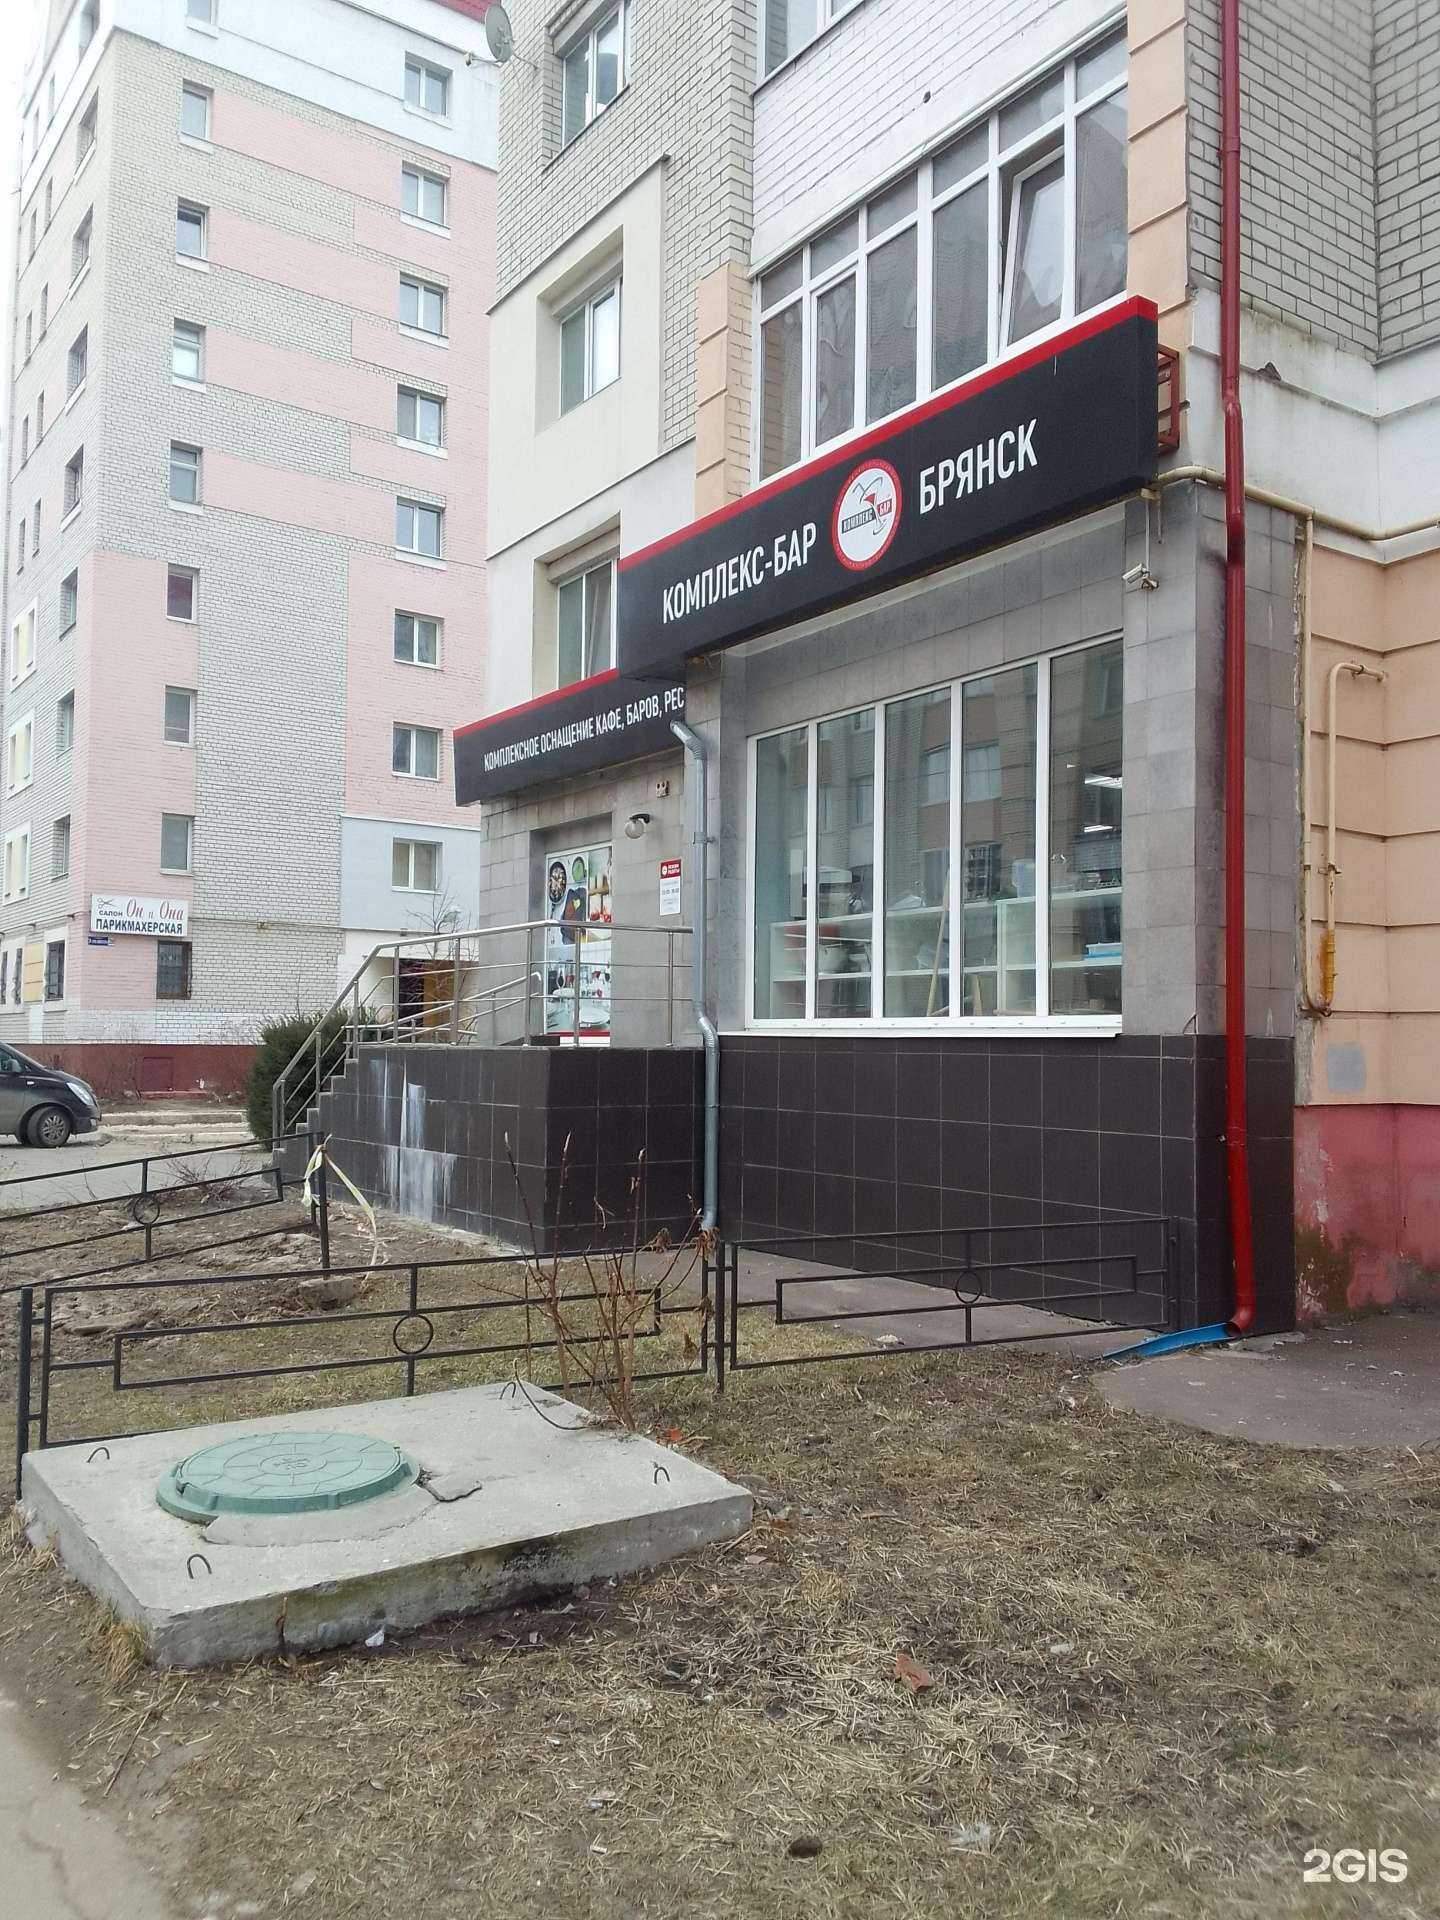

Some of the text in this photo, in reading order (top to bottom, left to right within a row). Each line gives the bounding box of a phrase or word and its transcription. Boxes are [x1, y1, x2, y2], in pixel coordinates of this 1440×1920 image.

[662, 418, 1038, 624] КОМПЛЕКС-БАР БРЯНСК
[484, 687, 685, 771] КОМПЛЕКСНОЕ ОСНАЩЕНИЕ КАФЕ, БАРОВ, РЕС
[96, 918, 183, 934] ПАРИКМАХЕРСКАЯ
[126, 899, 143, 918] Он
[159, 900, 184, 920] Она
